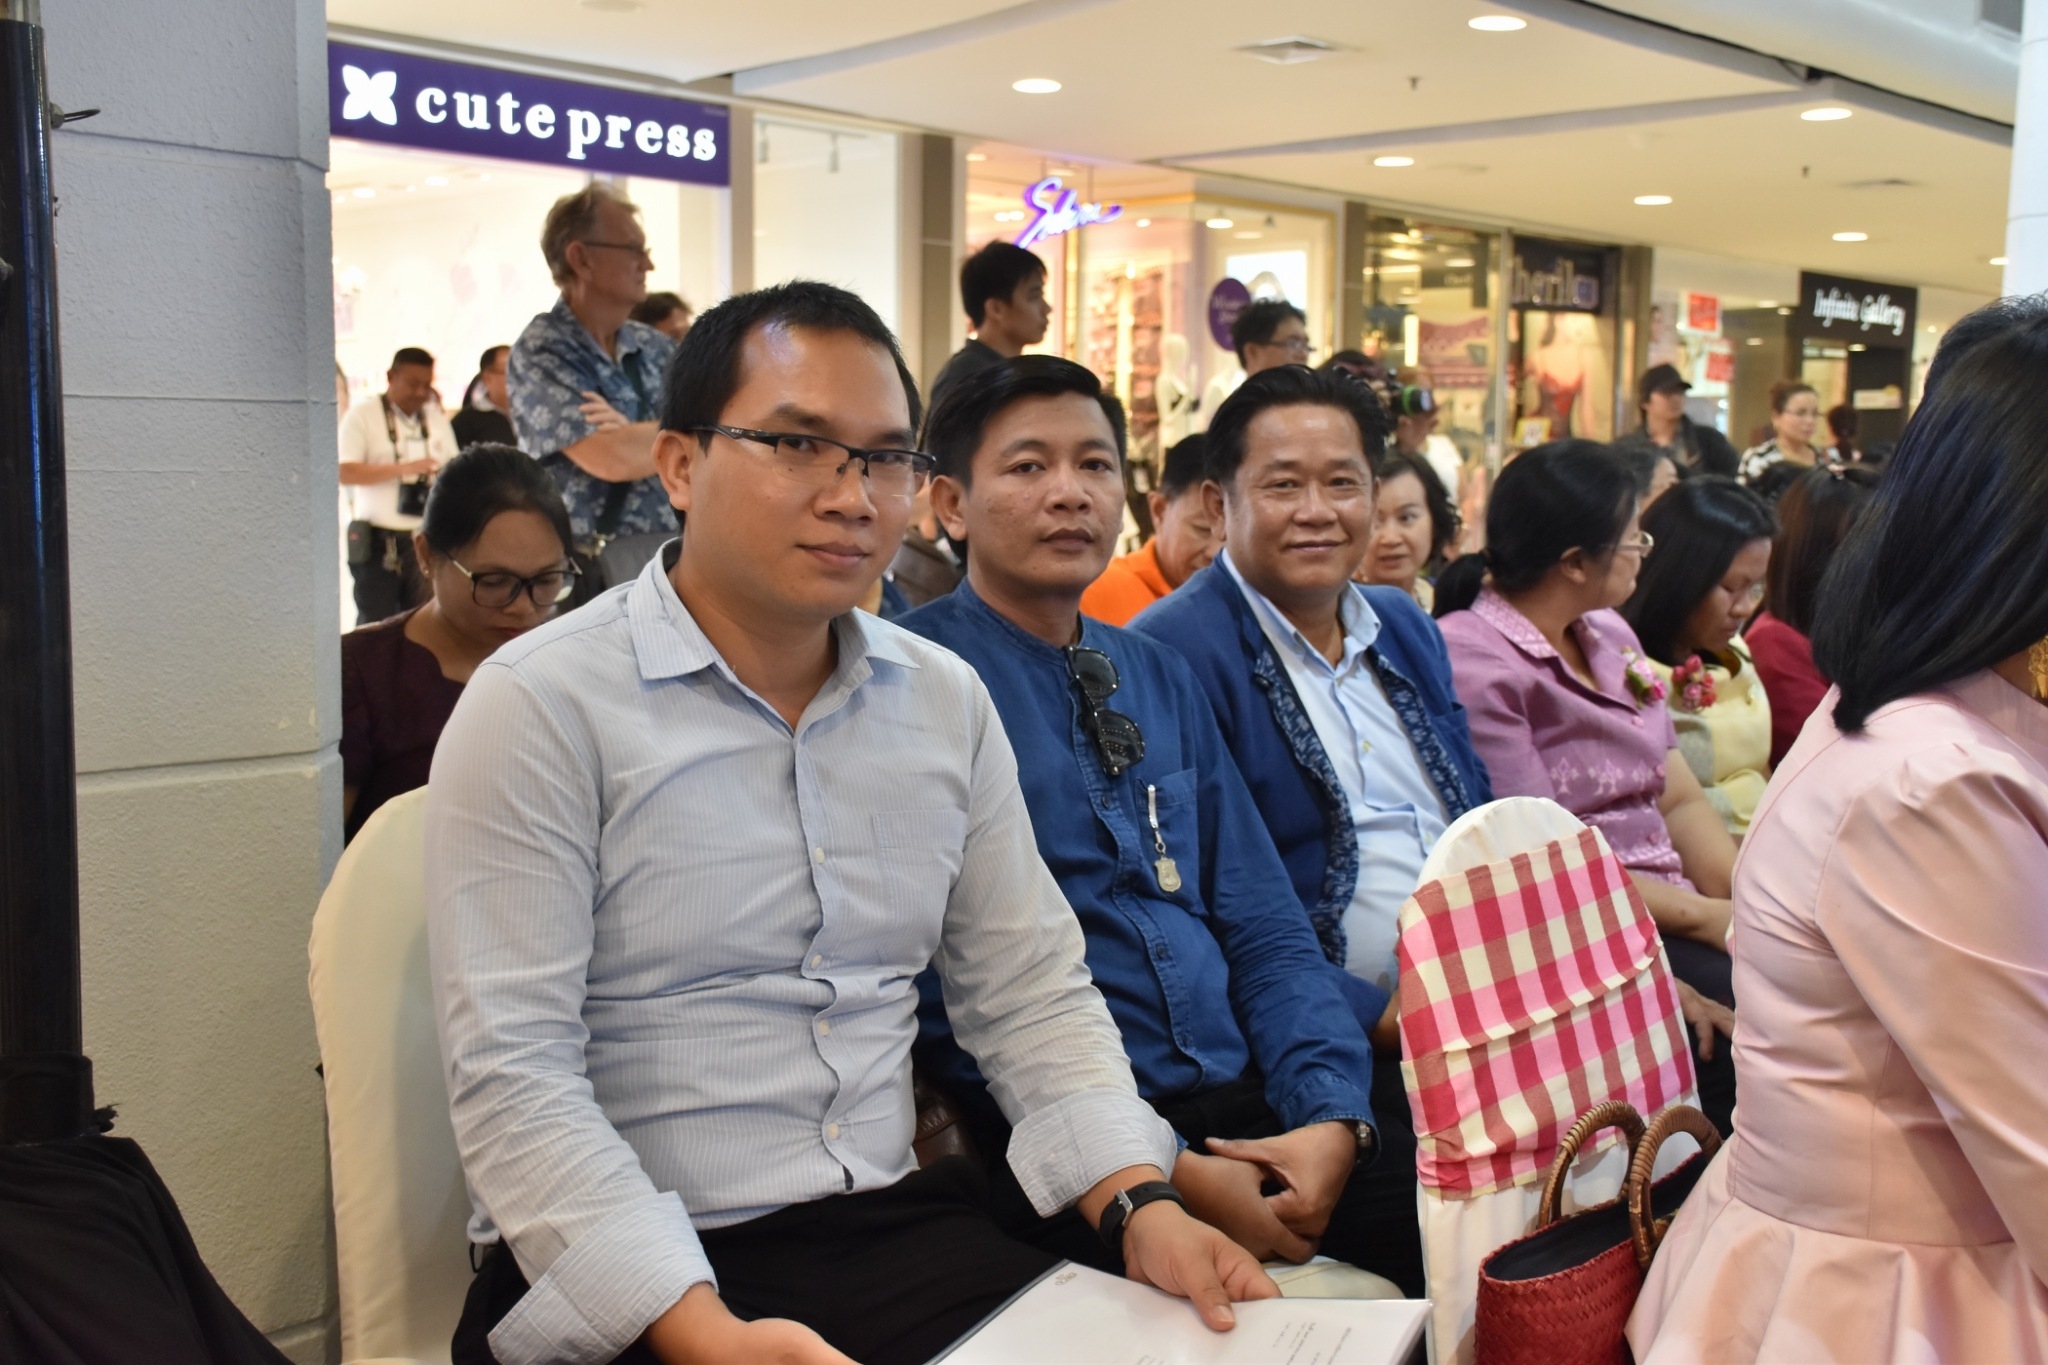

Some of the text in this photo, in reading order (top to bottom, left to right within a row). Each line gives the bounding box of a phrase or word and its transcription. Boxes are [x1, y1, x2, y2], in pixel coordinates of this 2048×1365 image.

[415, 86, 718, 160] cute press
[1813, 286, 1906, 336] Infinite Gallery
